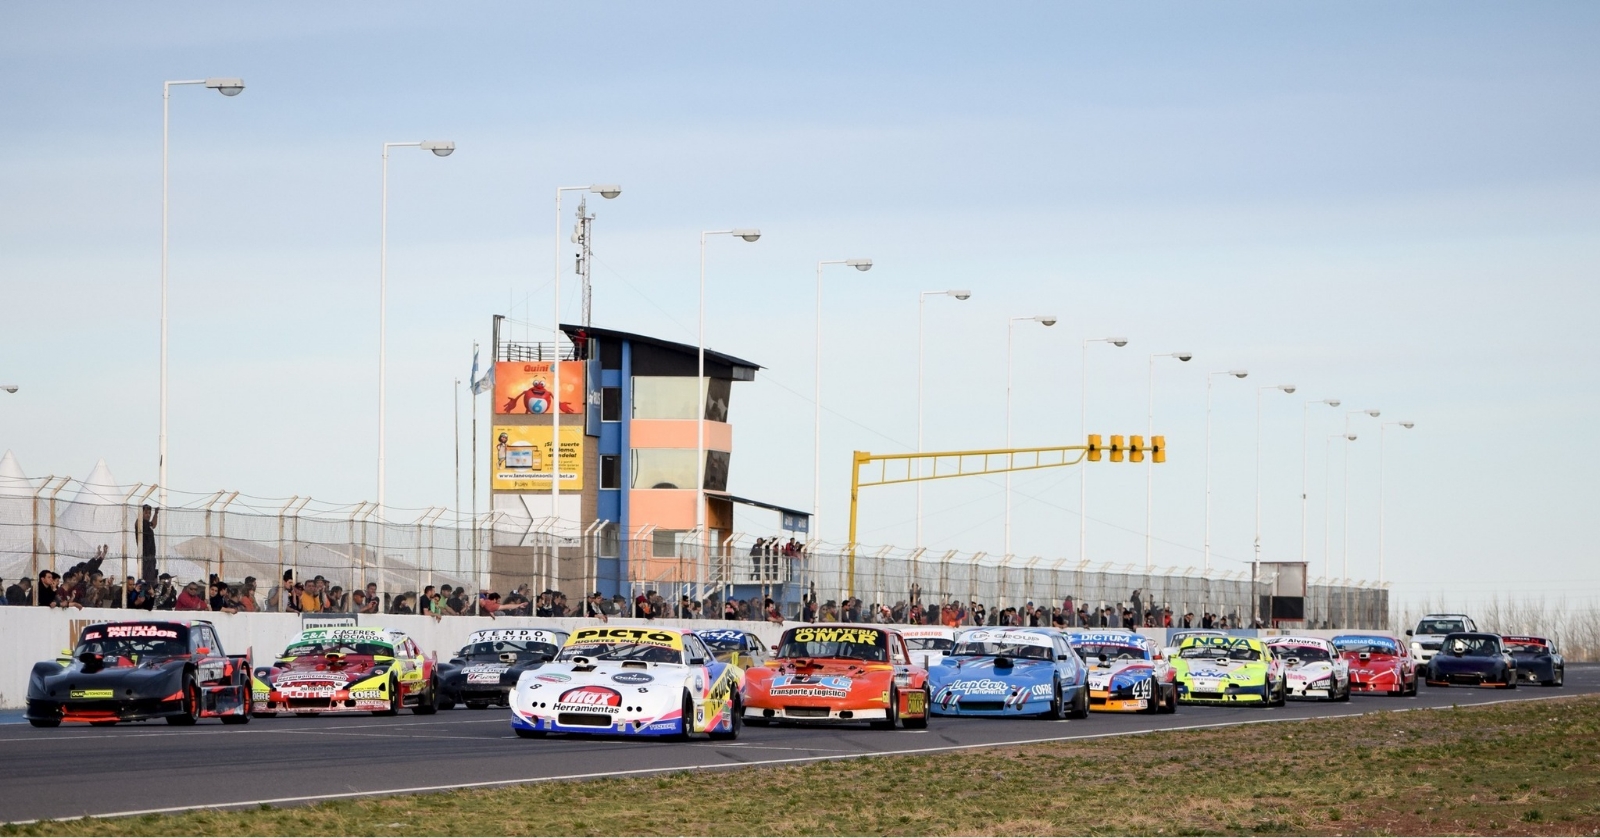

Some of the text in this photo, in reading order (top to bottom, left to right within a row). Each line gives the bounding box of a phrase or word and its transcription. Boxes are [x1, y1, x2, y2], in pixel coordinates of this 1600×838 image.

[523, 364, 549, 373] Quini
[532, 400, 543, 413] 6
[85, 632, 102, 640] EL
[301, 631, 327, 640] C&A
[577, 628, 674, 642] PICTÓ
[796, 627, 879, 638] HOJALATERIA
[332, 634, 385, 642] ASOCIADOS
[795, 631, 877, 646] OMAR
[994, 633, 1040, 642] GROUP
[1081, 634, 1130, 642] DICTUM
[1288, 638, 1321, 646] Alvarez
[620, 638, 672, 647] INCLUSIVOS
[1192, 637, 1252, 649] NOVA
[1184, 671, 1232, 680] NOVA
[950, 678, 1009, 695] LapCar
[1031, 683, 1053, 696] COFRE
[1132, 677, 1152, 700] 44
[252, 692, 271, 701] OFRE
[348, 690, 381, 699] COFRE
[770, 688, 808, 696] Transporte
[564, 690, 614, 705] Max
[552, 702, 620, 714] Herramientas
